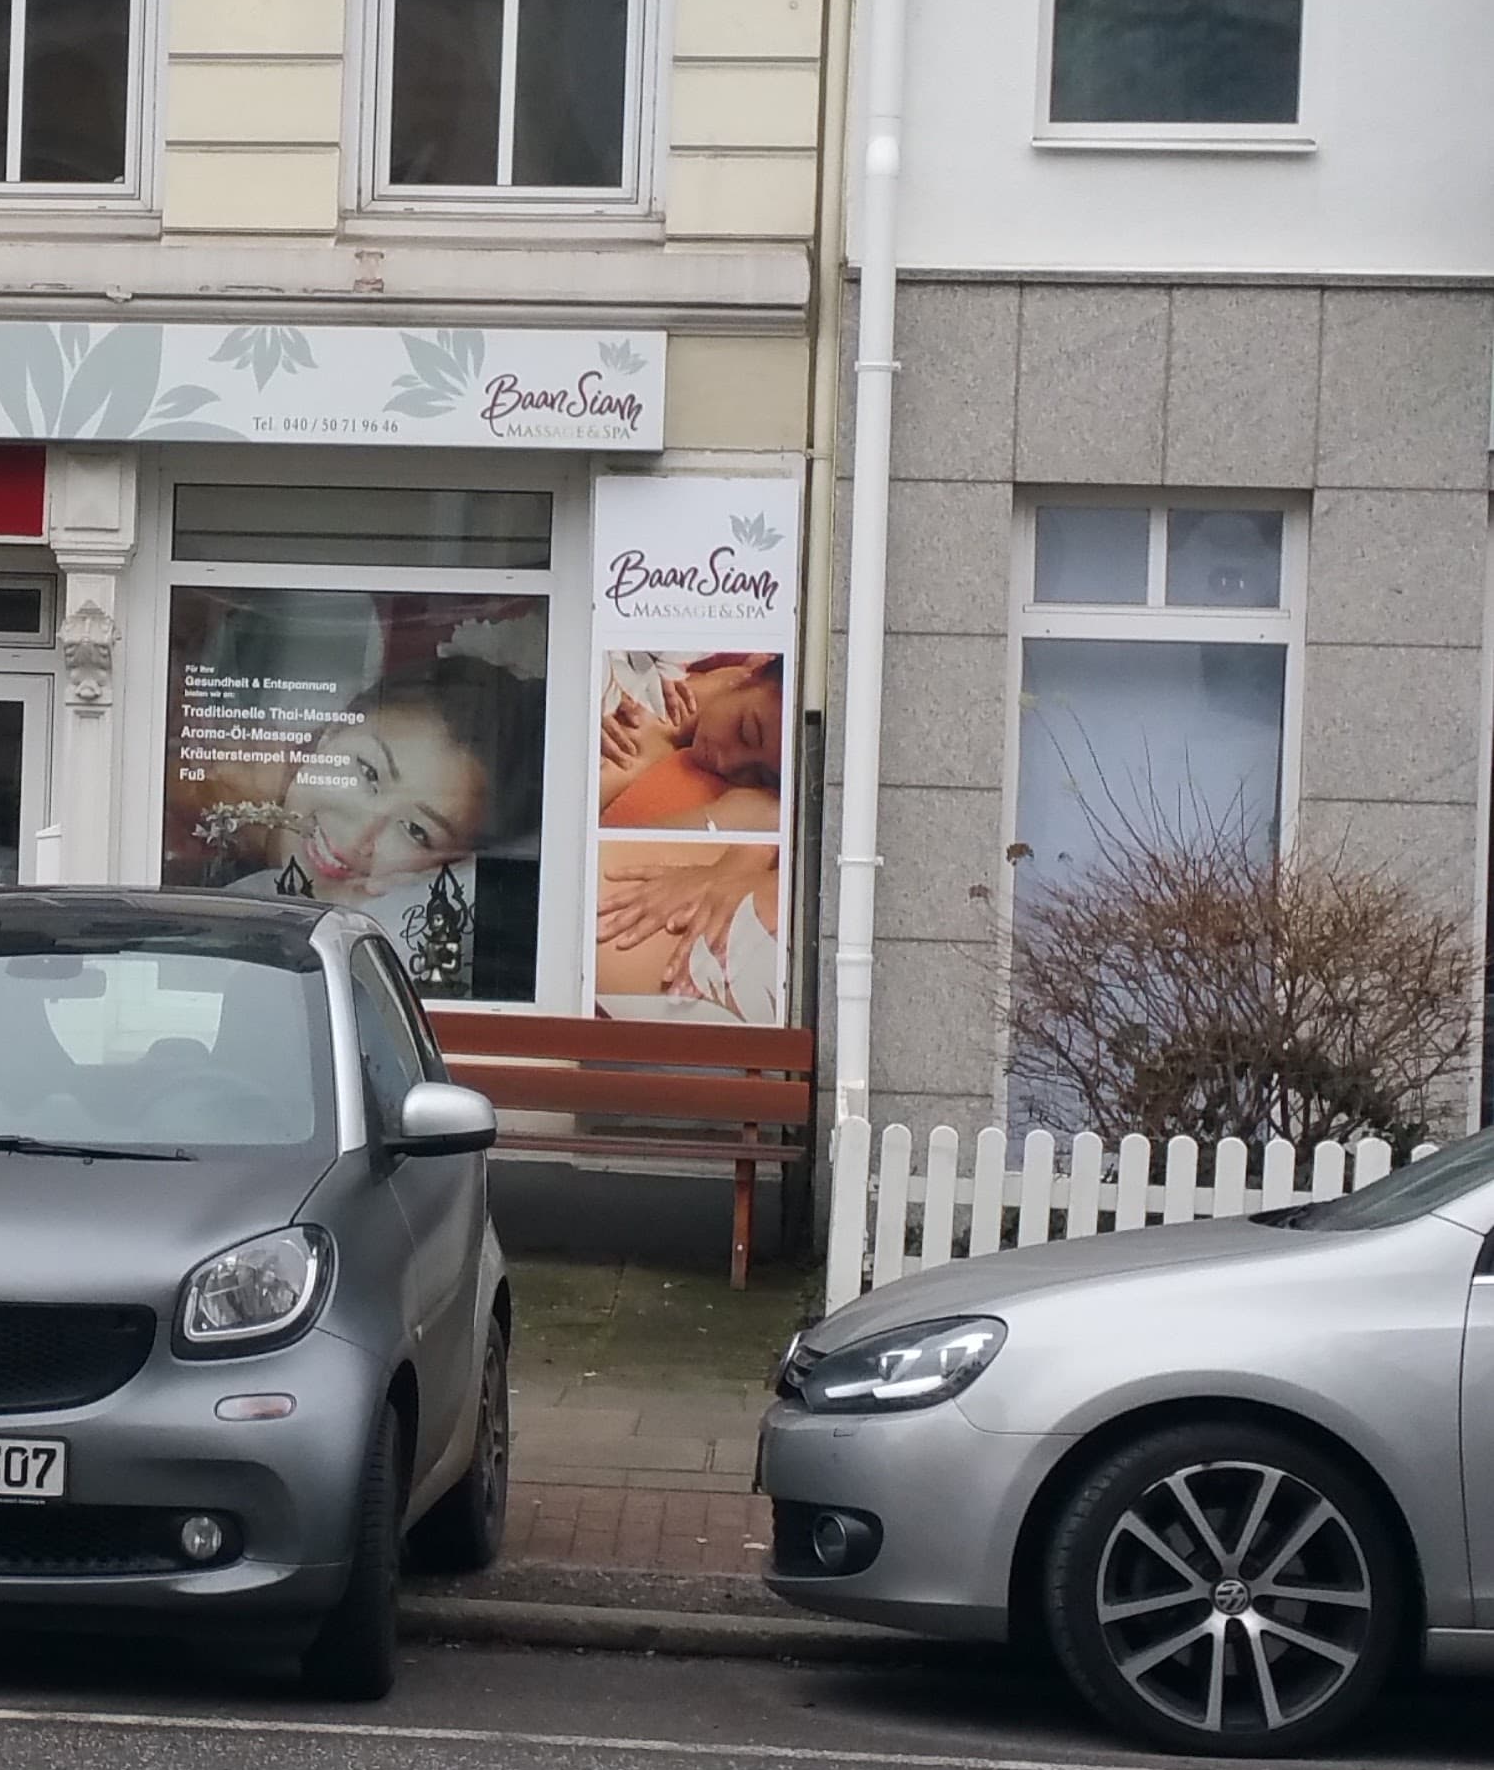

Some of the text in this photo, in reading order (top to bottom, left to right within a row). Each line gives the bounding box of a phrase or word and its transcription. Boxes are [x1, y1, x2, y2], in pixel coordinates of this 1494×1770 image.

[480, 370, 643, 437] Baan Siam
[283, 417, 307, 432] 040
[321, 417, 338, 432] 50
[342, 418, 357, 433] 71
[361, 419, 379, 433] 96
[382, 419, 400, 434] 46
[605, 546, 779, 618] Baan Siam
[185, 676, 337, 693] Gesundheit & Entspannung
[181, 704, 365, 725] Traditionelle Thai-Massage
[181, 725, 312, 744] Aroma-Öl-Massage
[180, 747, 351, 767] Kräuterstempel Massage
[179, 768, 358, 787] Fuß Massage
